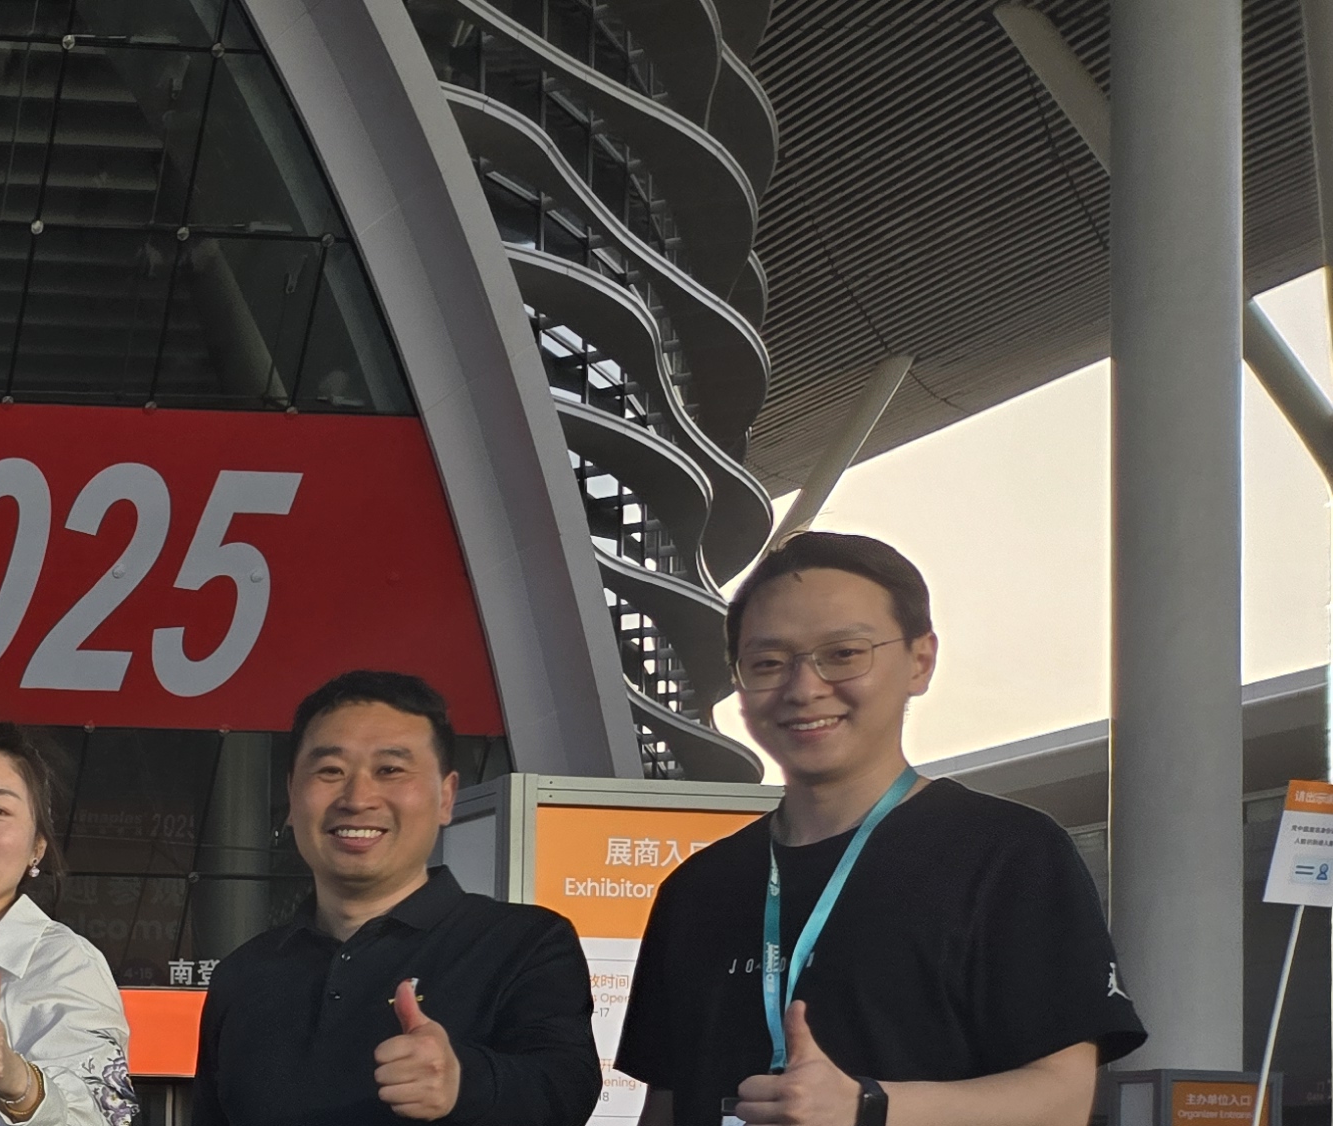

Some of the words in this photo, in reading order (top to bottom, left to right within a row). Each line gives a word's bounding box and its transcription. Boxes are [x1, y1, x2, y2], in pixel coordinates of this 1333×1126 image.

[564, 877, 655, 899] Exhibitor
[167, 957, 221, 986] 南登
[603, 1075, 636, 1091] ening
[1219, 1110, 1253, 1120] Entranc
